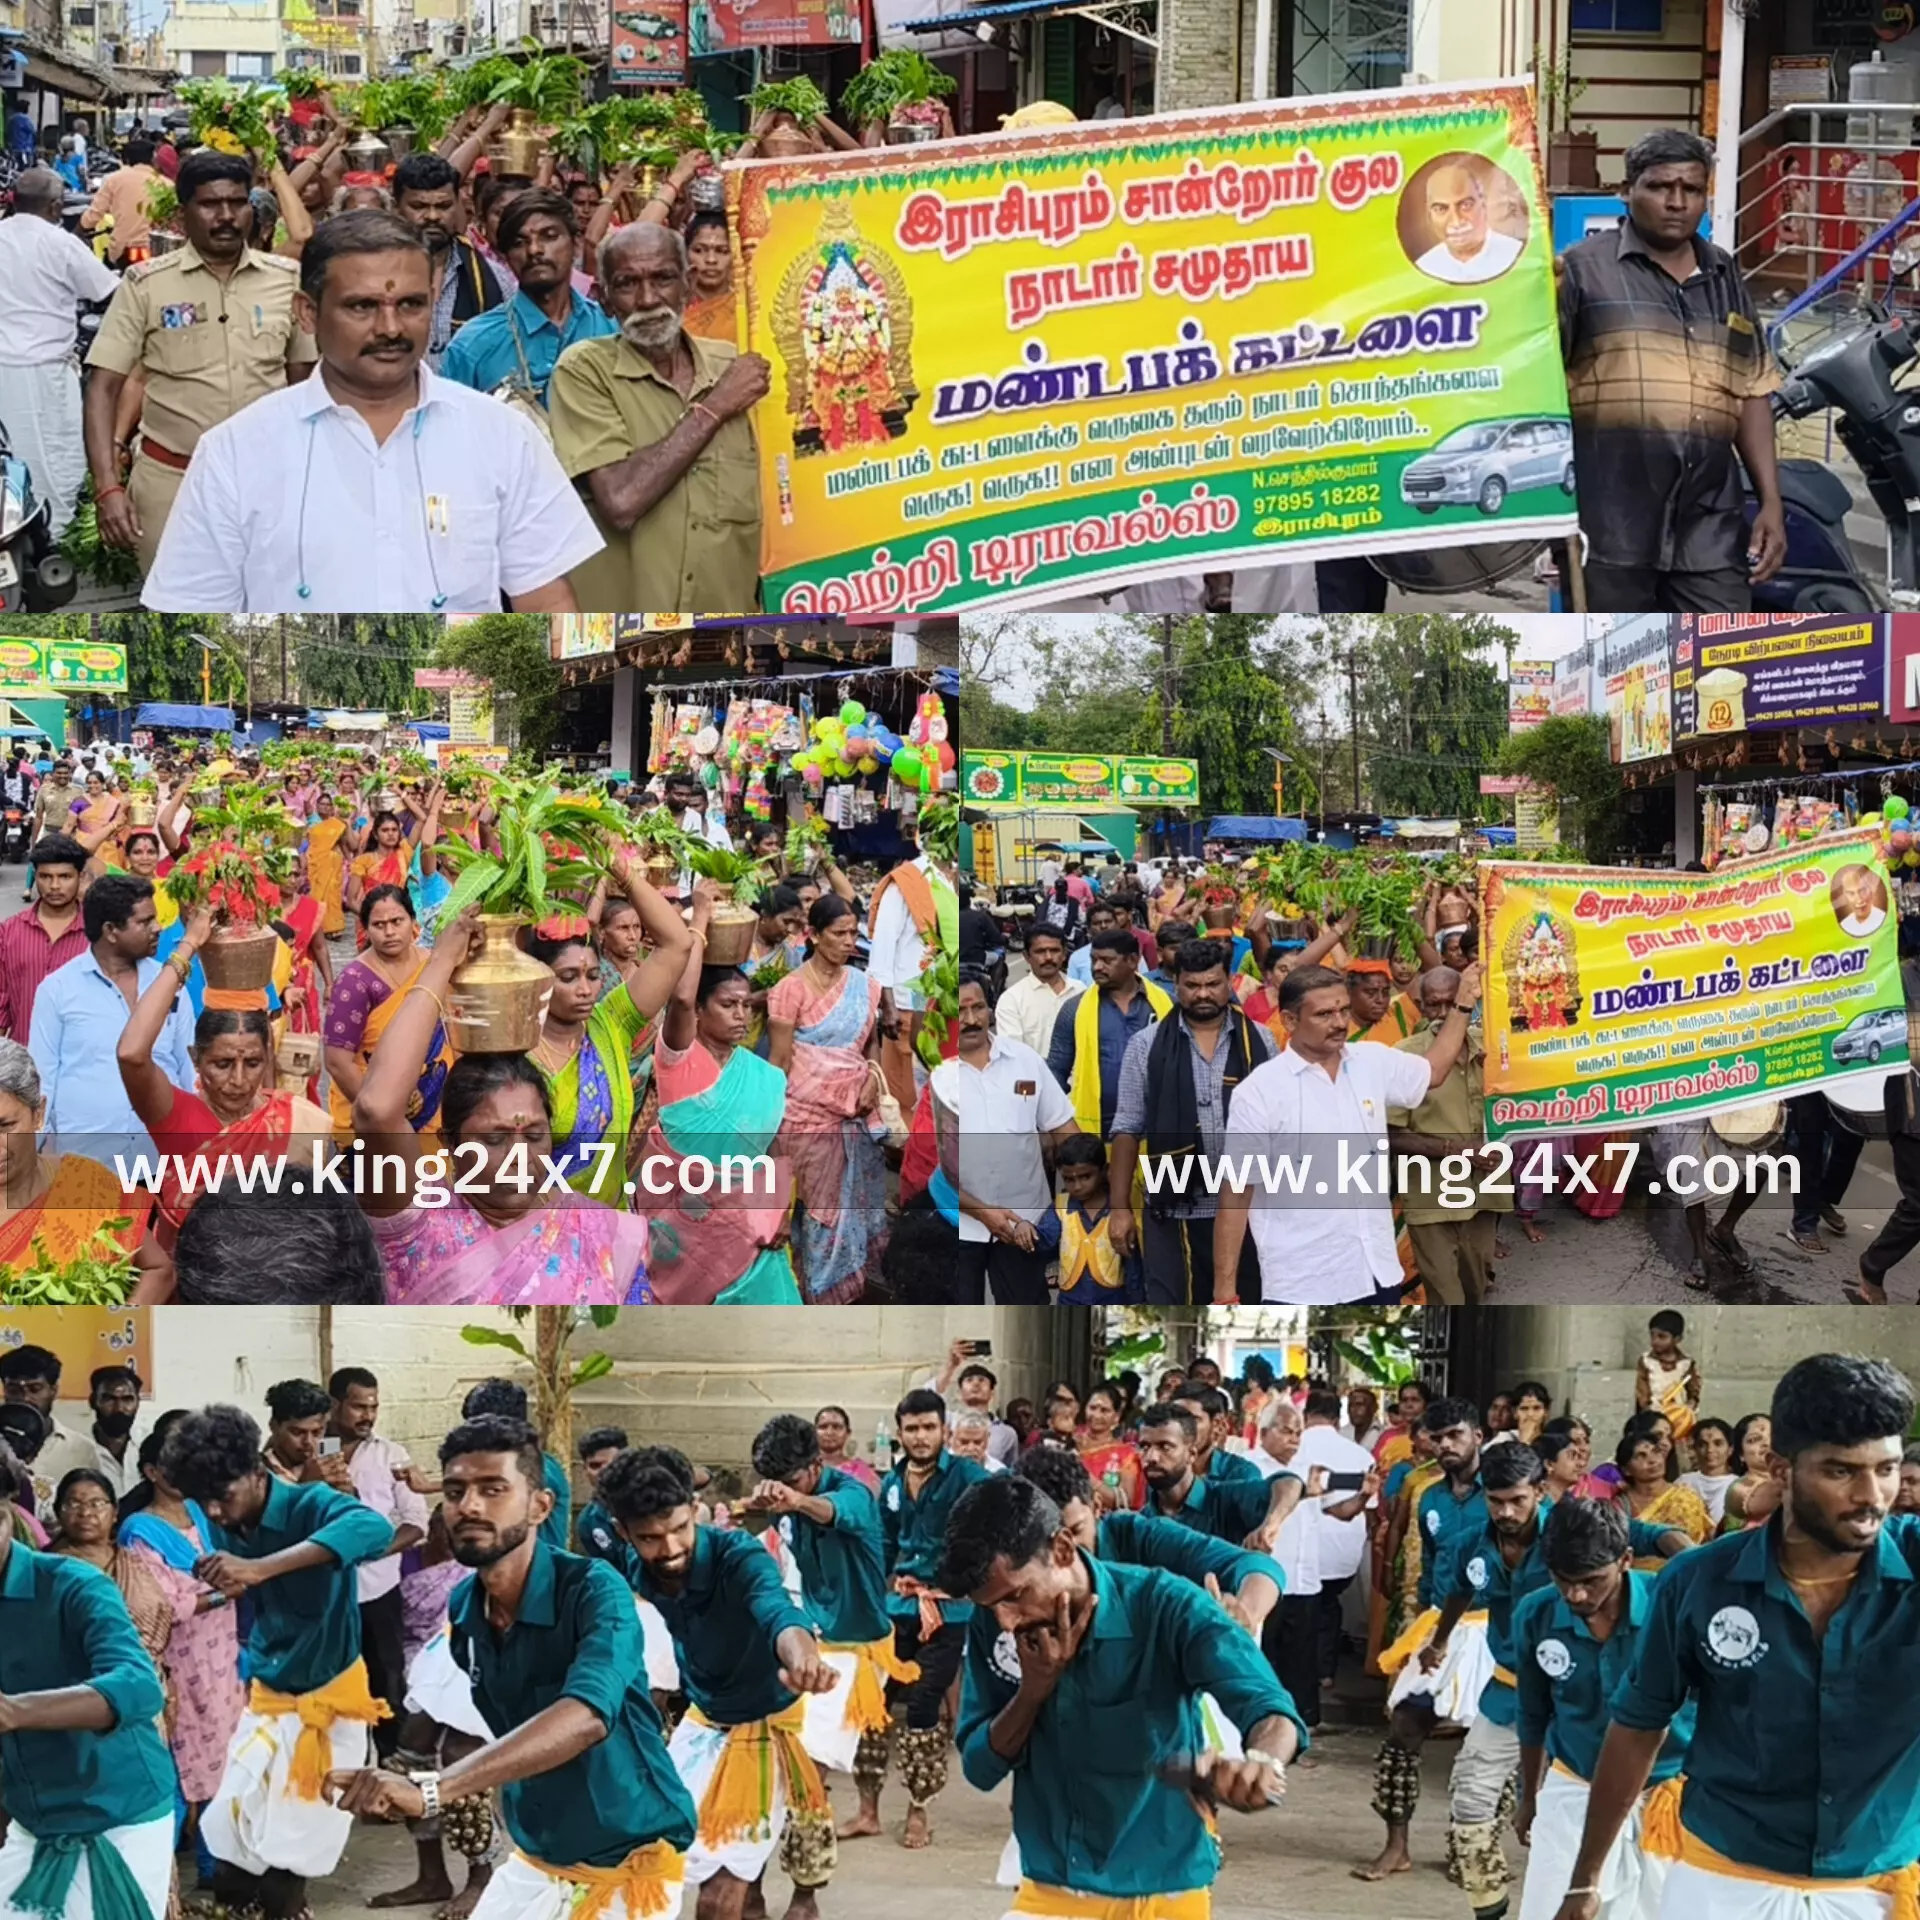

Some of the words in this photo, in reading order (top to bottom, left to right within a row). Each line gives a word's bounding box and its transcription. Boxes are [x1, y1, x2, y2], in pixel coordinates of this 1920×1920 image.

[898, 175, 1112, 253] இராசிபுரம்
[1125, 153, 1321, 220] சான்றோர்
[1332, 153, 1400, 206] குல
[1008, 247, 1139, 324] நாடார்
[1153, 237, 1311, 297] சமுதாய
[932, 321, 1218, 421] மண்டபக்
[1233, 304, 1485, 376] கட்டளை
[826, 449, 932, 497] மண்டபக்
[940, 424, 1078, 469] கட்டளைக்கு
[1088, 407, 1175, 441] வருகை
[1183, 393, 1243, 430] தரும்
[1252, 382, 1320, 420] நாடார்
[1330, 367, 1500, 406] சொந்தங்களை
[903, 482, 972, 520] வருக!
[982, 464, 1060, 500] வருக!!
[1070, 456, 1114, 483] என
[1125, 434, 1232, 473] அன்புடன்
[1253, 491, 1315, 515] 97895
[1320, 483, 1381, 506] 18282
[972, 484, 1238, 586] டிராவல்ஸ்
[1252, 506, 1383, 537] இராசிபுரம்
[1743, 636, 1802, 659] விற்பனை
[1804, 626, 1866, 650] நிலையம்
[1714, 706, 1726, 720] 12
[1574, 890, 1689, 924] இராசிபுரம்
[1785, 867, 1828, 893] குல
[1626, 923, 1701, 958] நாடார்
[1706, 911, 1792, 945] சமுதாய
[1592, 956, 1742, 1016] மண்டபக்
[1747, 947, 1870, 989] கட்டளை
[1493, 1088, 1609, 1125] வெற்றி
[1615, 1056, 1760, 1116] டிராவல்ஸ்
